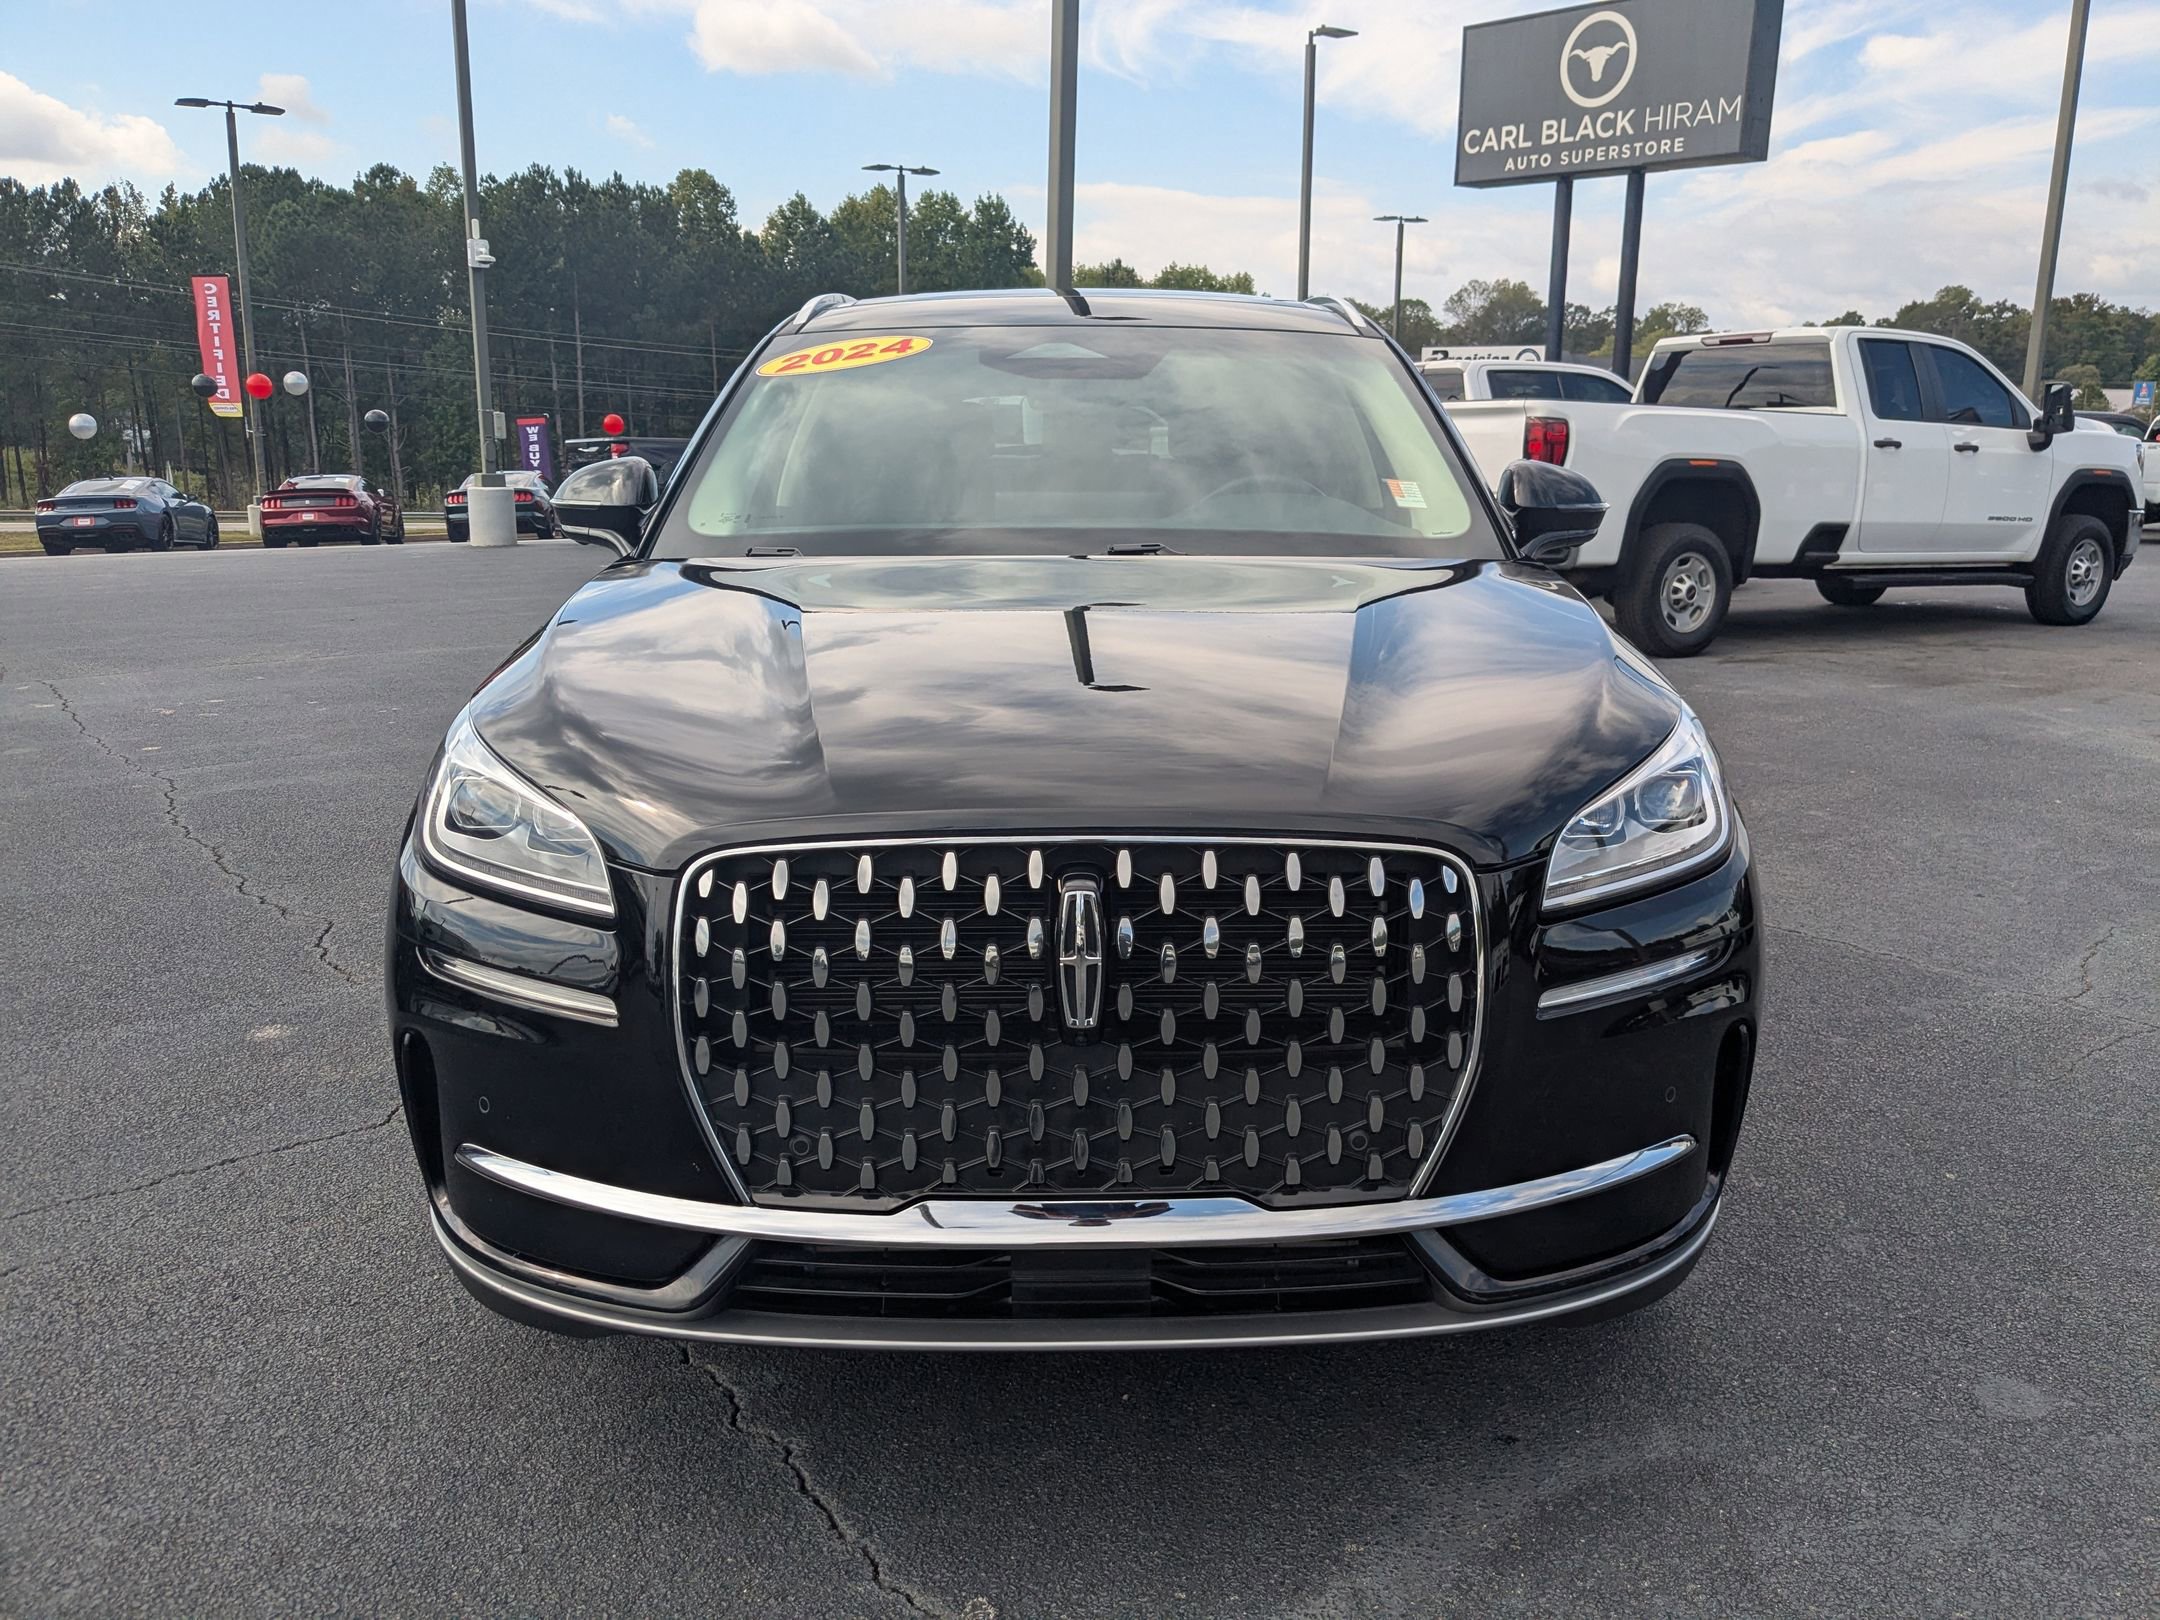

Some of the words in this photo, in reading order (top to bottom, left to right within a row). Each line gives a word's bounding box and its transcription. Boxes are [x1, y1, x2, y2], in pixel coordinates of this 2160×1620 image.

[1463, 123, 1532, 154] CARL
[1541, 109, 1636, 147] BLACK
[1643, 94, 1743, 133] HIRAM
[1504, 153, 1552, 172] AUTO
[1560, 137, 1685, 166] SUPERSTORE
[774, 338, 914, 373] 2024
